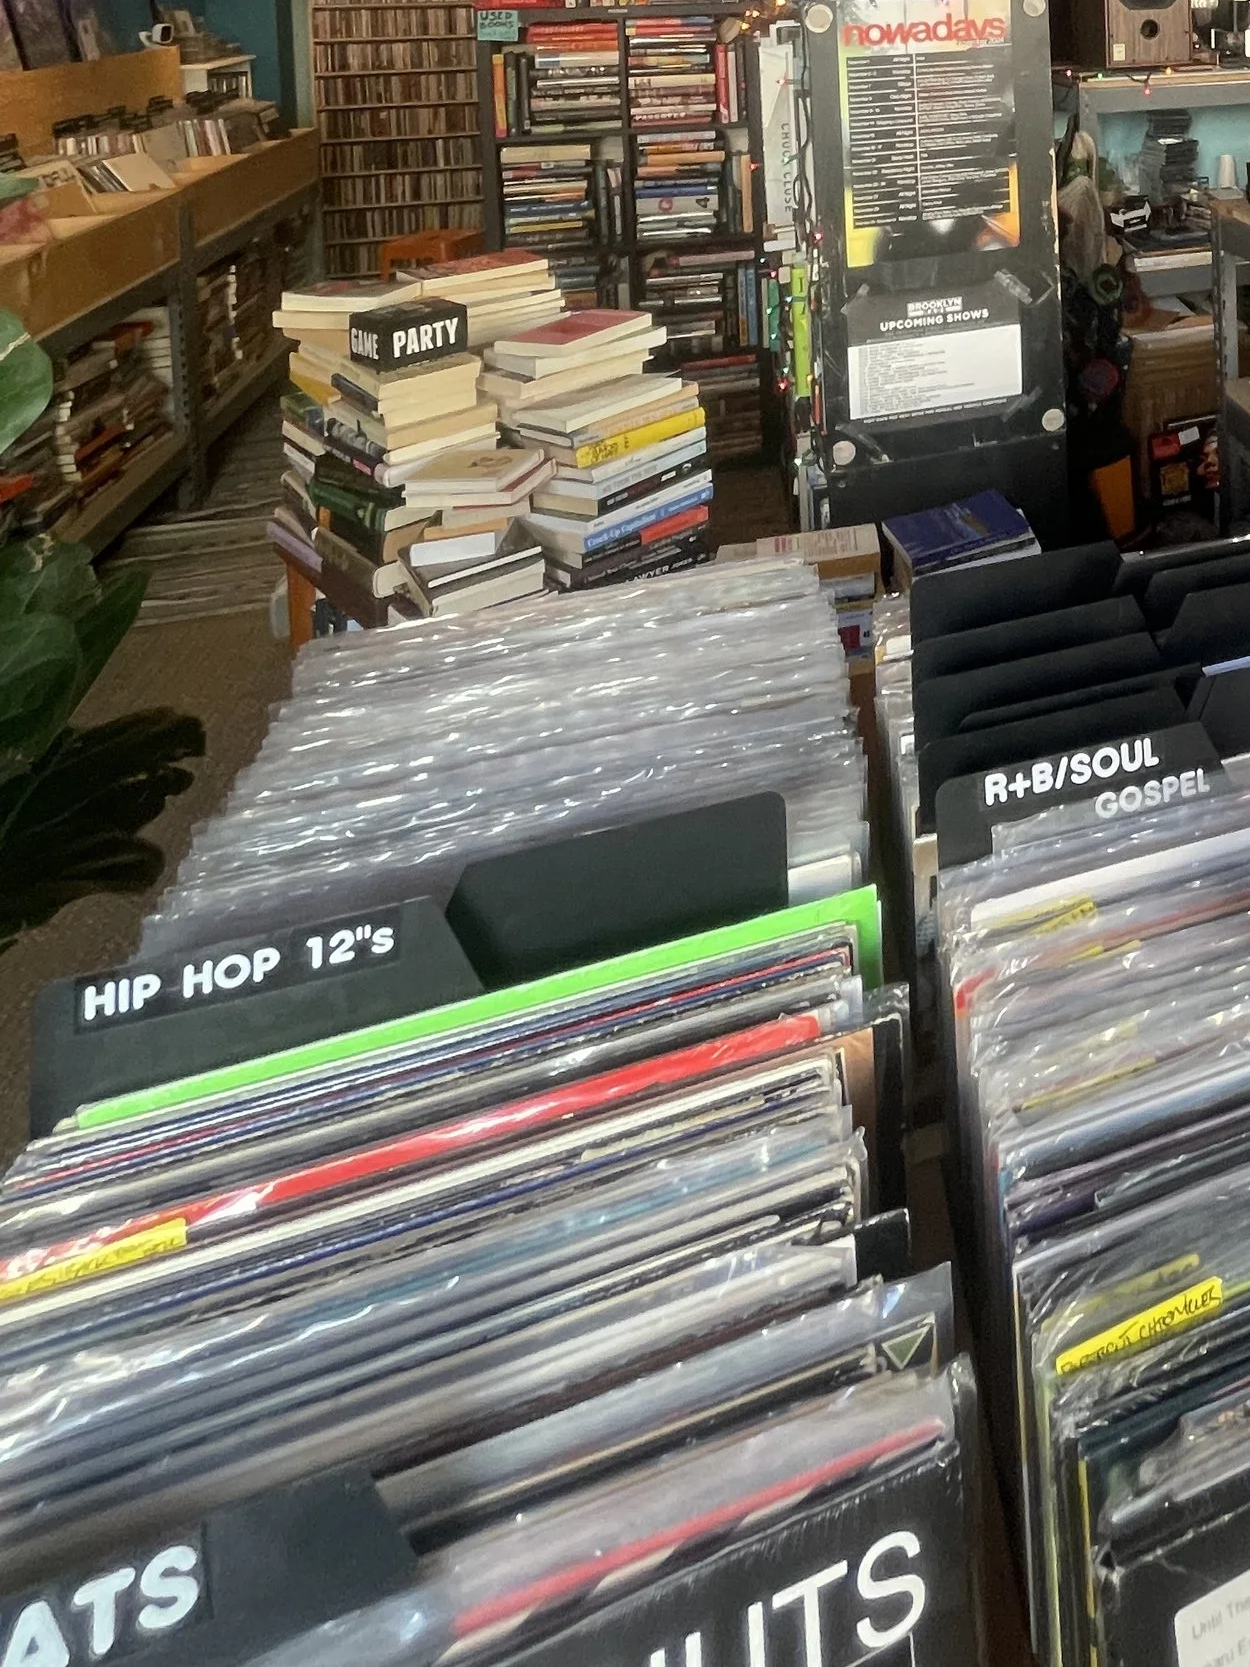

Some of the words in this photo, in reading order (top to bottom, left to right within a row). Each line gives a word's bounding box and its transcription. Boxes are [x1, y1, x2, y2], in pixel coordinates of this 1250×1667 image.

[480, 11, 513, 21] USED
[480, 20, 514, 30] BOOKS
[842, 13, 1007, 47] nowadays
[907, 297, 963, 311] BROOKLYN
[880, 314, 944, 332] UPCOMING
[946, 308, 990, 323] SHOWS
[351, 327, 379, 360] GAME
[392, 317, 459, 359] PARTY
[625, 564, 670, 583] AWYER
[984, 737, 1160, 805] R+B/SOUL
[1094, 768, 1210, 819] GOSPEL
[83, 973, 161, 1022] HIP
[182, 947, 281, 1000] HOP
[1192, 1610, 1222, 1641] Until
